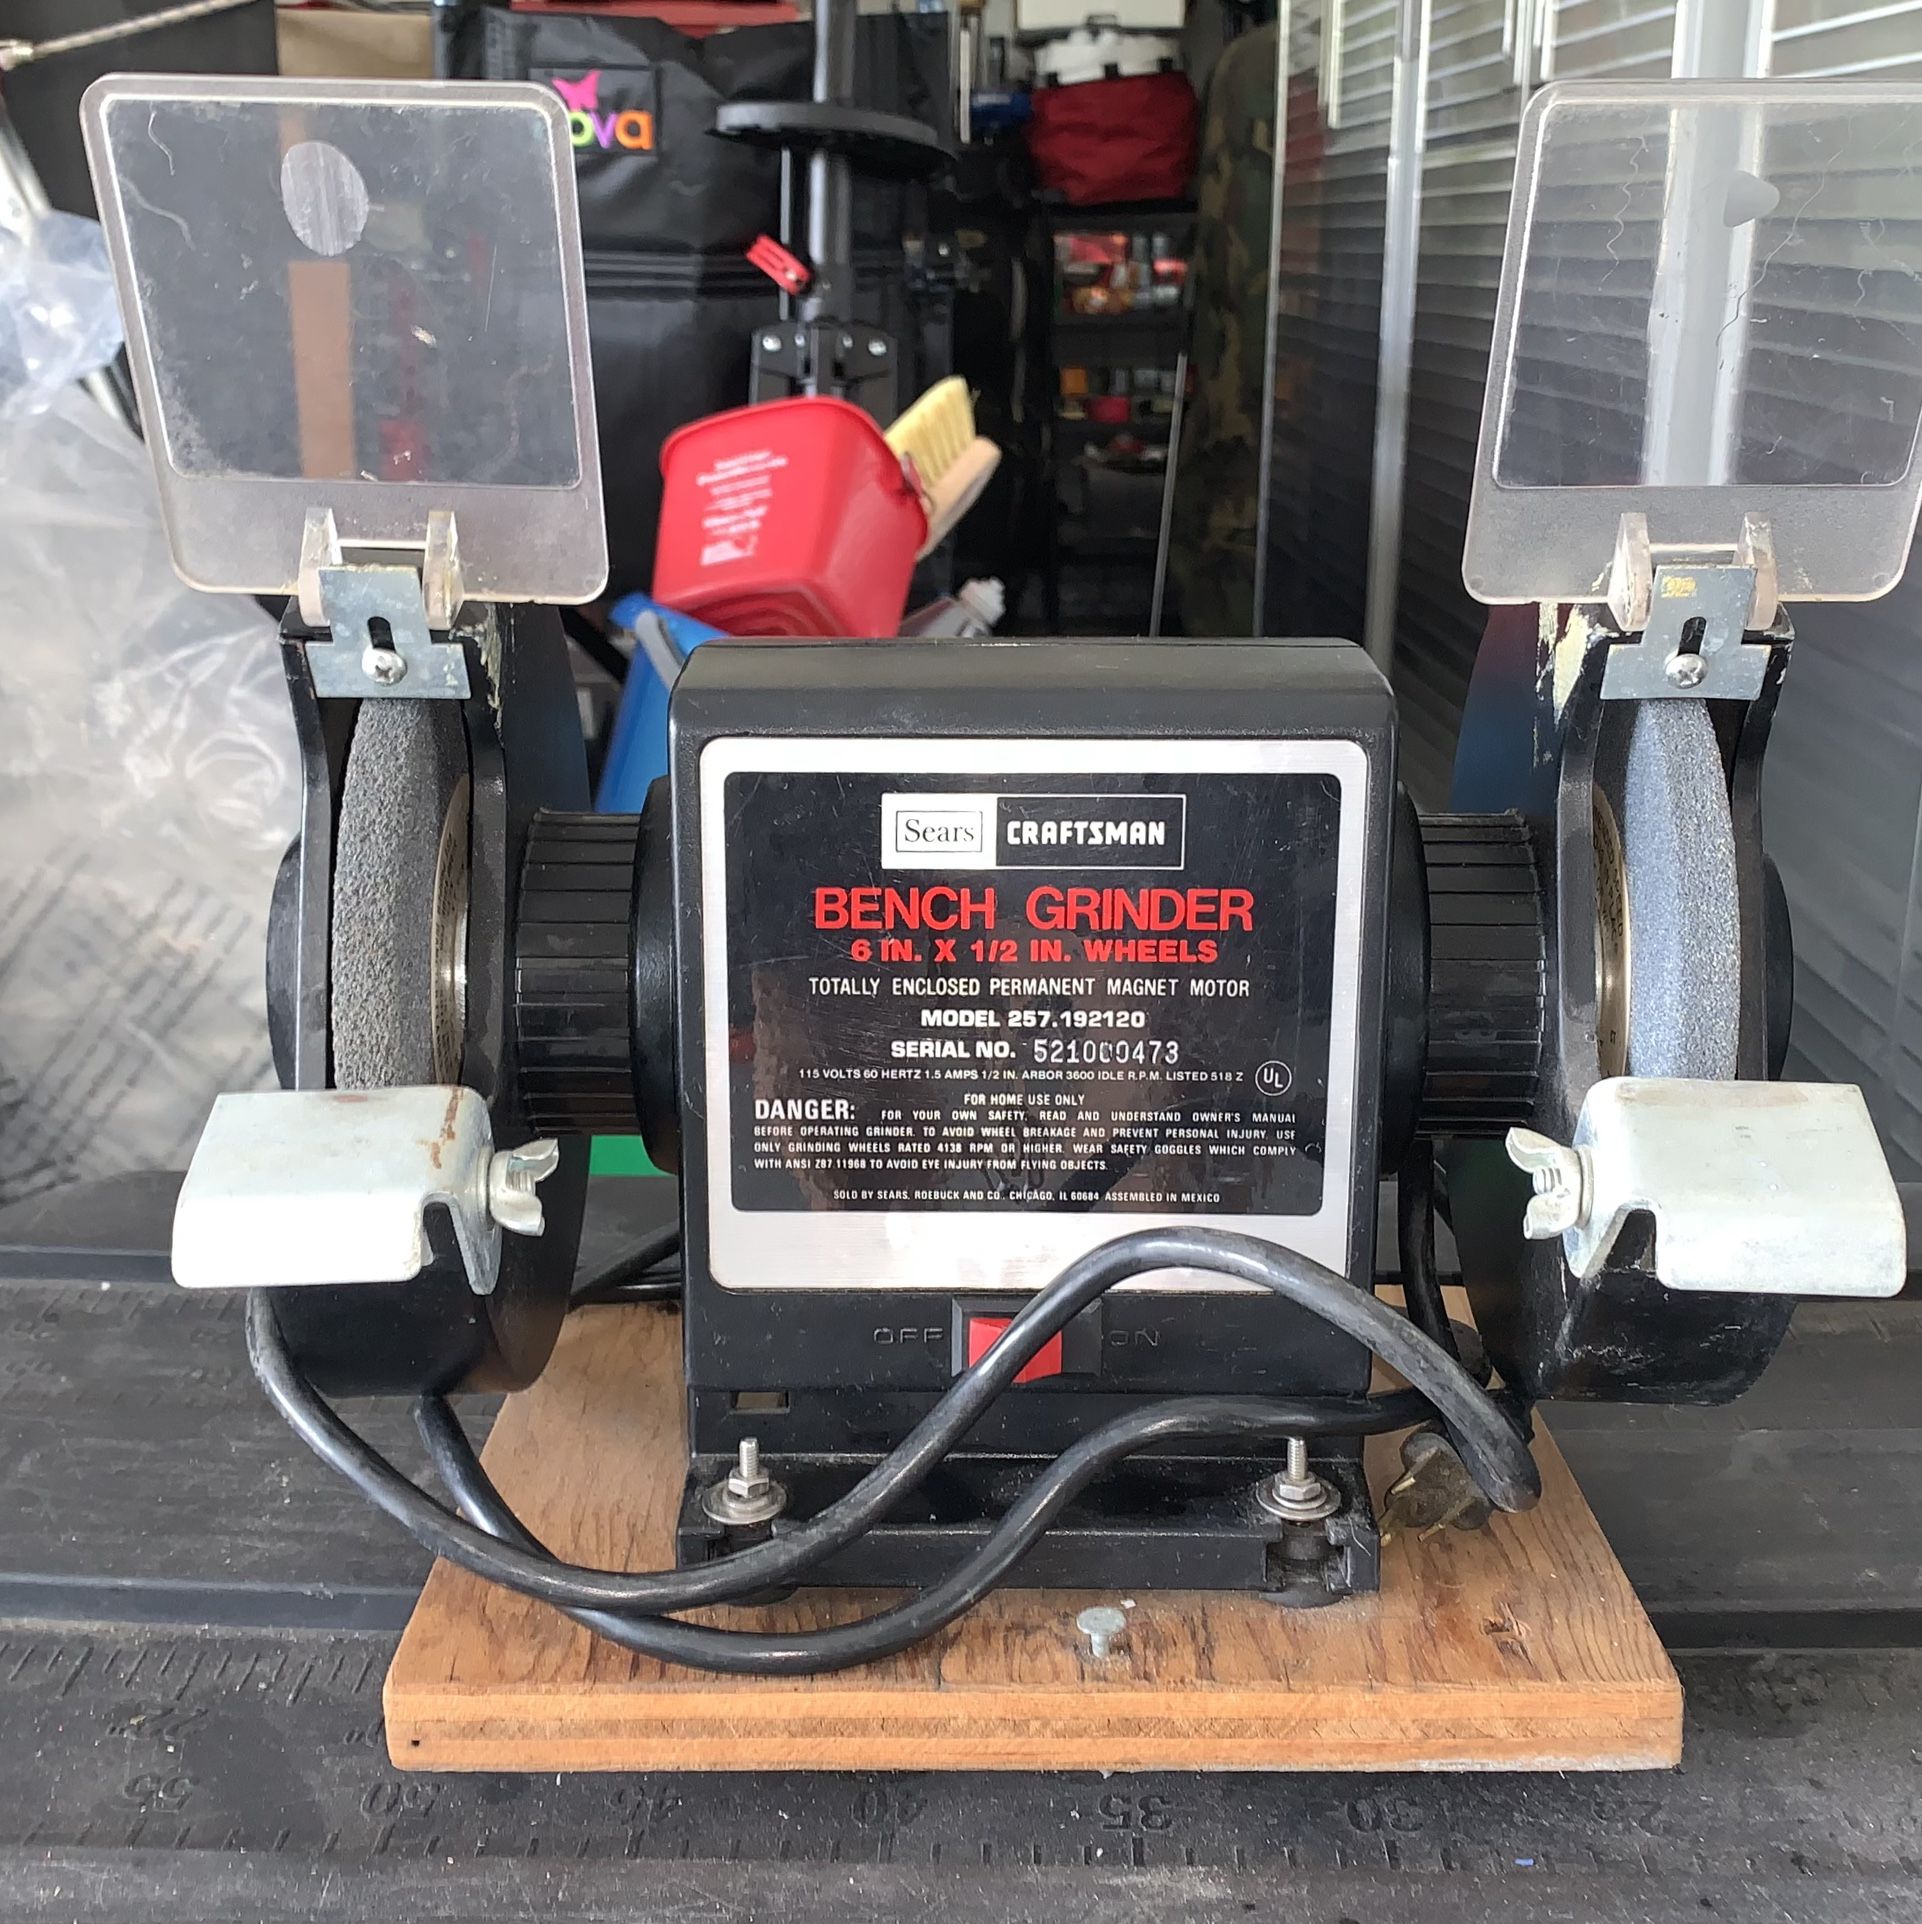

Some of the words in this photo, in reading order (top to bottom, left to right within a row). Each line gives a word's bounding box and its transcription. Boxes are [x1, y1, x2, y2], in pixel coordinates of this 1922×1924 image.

[569, 110, 655, 150] ova
[904, 818, 975, 843] Sears
[1006, 820, 1165, 845] CRAFTSMAN
[814, 886, 996, 931] BENCH
[1025, 886, 1254, 931] GRINDER
[851, 939, 872, 962] 6
[880, 938, 922, 962] IN.
[934, 939, 956, 963] X
[971, 939, 1018, 963] 1/2
[1030, 939, 1071, 962] IN.
[1083, 939, 1217, 963] WHEELS
[809, 977, 880, 997] TOTALLY
[893, 978, 980, 996] ENCLOSED
[990, 978, 1095, 996] PERMANENT
[1108, 978, 1179, 996] MAGNET
[1190, 979, 1249, 997] MOTOR
[921, 1009, 1000, 1027] MODEL
[1008, 1010, 1149, 1028] 257.192120
[891, 1038, 970, 1058] SERIAL
[976, 1041, 1015, 1058] NO.
[800, 1068, 820, 1079] 115
[822, 1068, 860, 1079] VOLTS
[863, 1068, 878, 1079] 60
[881, 1069, 921, 1079] HERTZ
[924, 1069, 941, 1080] 1.5
[945, 1069, 978, 1080] AMPS
[982, 1069, 999, 1080] 1/2
[1003, 1069, 1018, 1080] IN.
[1022, 1070, 1063, 1080] ARBOR
[1066, 1070, 1094, 1081] 3600
[1098, 1070, 1124, 1081] IDLE
[1128, 1070, 1162, 1081] R.P.M.
[1166, 1071, 1208, 1081] LISTED
[964, 1093, 986, 1105] FOR
[991, 1094, 1023, 1105] HOME
[1028, 1093, 1050, 1105] USE
[1055, 1094, 1084, 1105] ONLY
[755, 1099, 855, 1119] DANGER:
[881, 1110, 901, 1121] FOR
[913, 1110, 940, 1120] YOUR
[952, 1110, 977, 1120] OWN
[1040, 1111, 1066, 1120] READ
[1078, 1111, 1099, 1120] AND
[1111, 1111, 1181, 1121] UNDERSTAND
[1193, 1112, 1240, 1122] OWNER'S
[754, 1126, 792, 1136] BEFORE
[801, 1126, 859, 1136] OPERATING
[923, 1126, 935, 1136] TO
[942, 1126, 974, 1137] AVOID
[981, 1127, 1016, 1137] WHEEL
[1023, 1127, 1076, 1137] BREAKAGE
[1083, 1127, 1105, 1137] AND
[1113, 1128, 1158, 1138] PREVENT
[1166, 1128, 1219, 1138] PERSONAL
[1277, 1130, 1295, 1140] USE
[754, 1142, 780, 1152] ONLY
[788, 1142, 840, 1152] GRINDING
[849, 1142, 890, 1152] WHEELS
[898, 1143, 930, 1153] RATED
[970, 1143, 993, 1153] RPM
[1001, 1143, 1015, 1153] OR
[1073, 1144, 1102, 1153] WEAR
[1111, 1144, 1147, 1155] SAFETY
[1155, 1145, 1201, 1154] GOGGLES
[1209, 1145, 1245, 1155] WHICH
[1253, 1146, 1296, 1156] COMPLY
[754, 1159, 782, 1169] WITH
[786, 1159, 810, 1169] ANSI
[870, 1159, 883, 1169] TO
[886, 1159, 918, 1169] AVOID
[922, 1159, 939, 1169] EYE
[944, 1159, 983, 1169] INJURY
[987, 1159, 1016, 1169] FROM
[1021, 1160, 1056, 1169] FLYING
[834, 1189, 857, 1199] SOLD
[862, 1190, 873, 1199] BY
[915, 1190, 959, 1199] ROEBUCK
[963, 1190, 981, 1200] AND
[1059, 1191, 1067, 1200] IL
[1071, 1191, 1099, 1200] 60684
[1105, 1191, 1162, 1201] ASSEMBLED
[1167, 1193, 1177, 1202] IN
[1182, 1193, 1219, 1202] MEXICO
[874, 1327, 943, 1345] OFF
[1110, 1328, 1159, 1346] ON
[1102, 1792, 1173, 1832] 35
